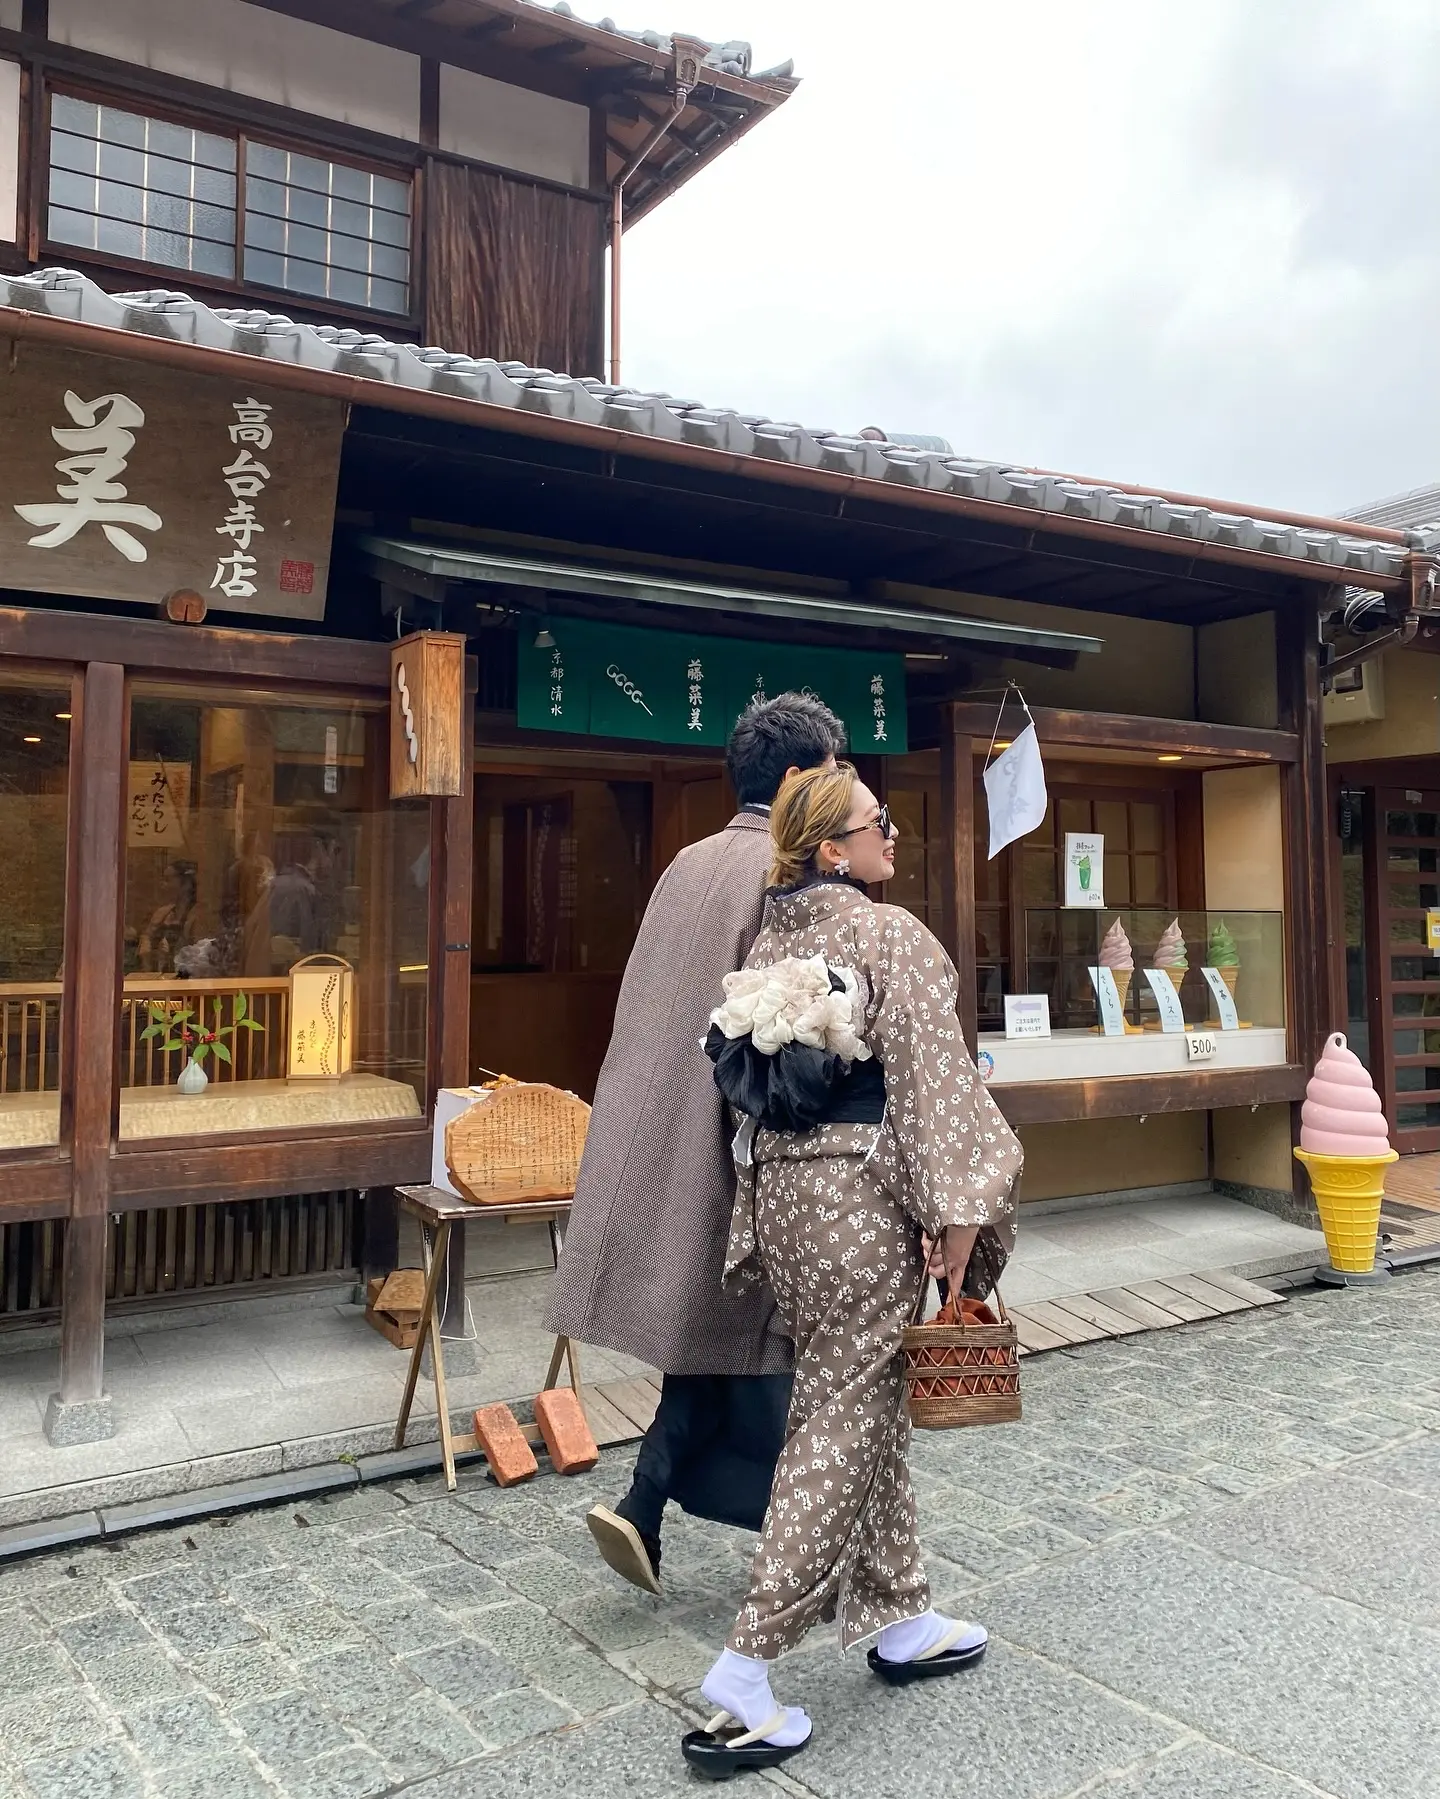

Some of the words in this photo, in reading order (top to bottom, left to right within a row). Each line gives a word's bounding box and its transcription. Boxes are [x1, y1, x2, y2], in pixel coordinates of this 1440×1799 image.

[13, 389, 163, 563] 美
[209, 396, 273, 598] 高台寺店
[550, 649, 564, 717] 京都清水
[687, 658, 704, 732] 藤菜美
[870, 674, 888, 742] 藤菜美
[132, 793, 149, 837] だんご
[151, 771, 168, 834] みたらし
[1100, 973, 1114, 1009] さくら
[1209, 972, 1228, 1001] 抹茶
[1191, 1038, 1217, 1055] 500円
